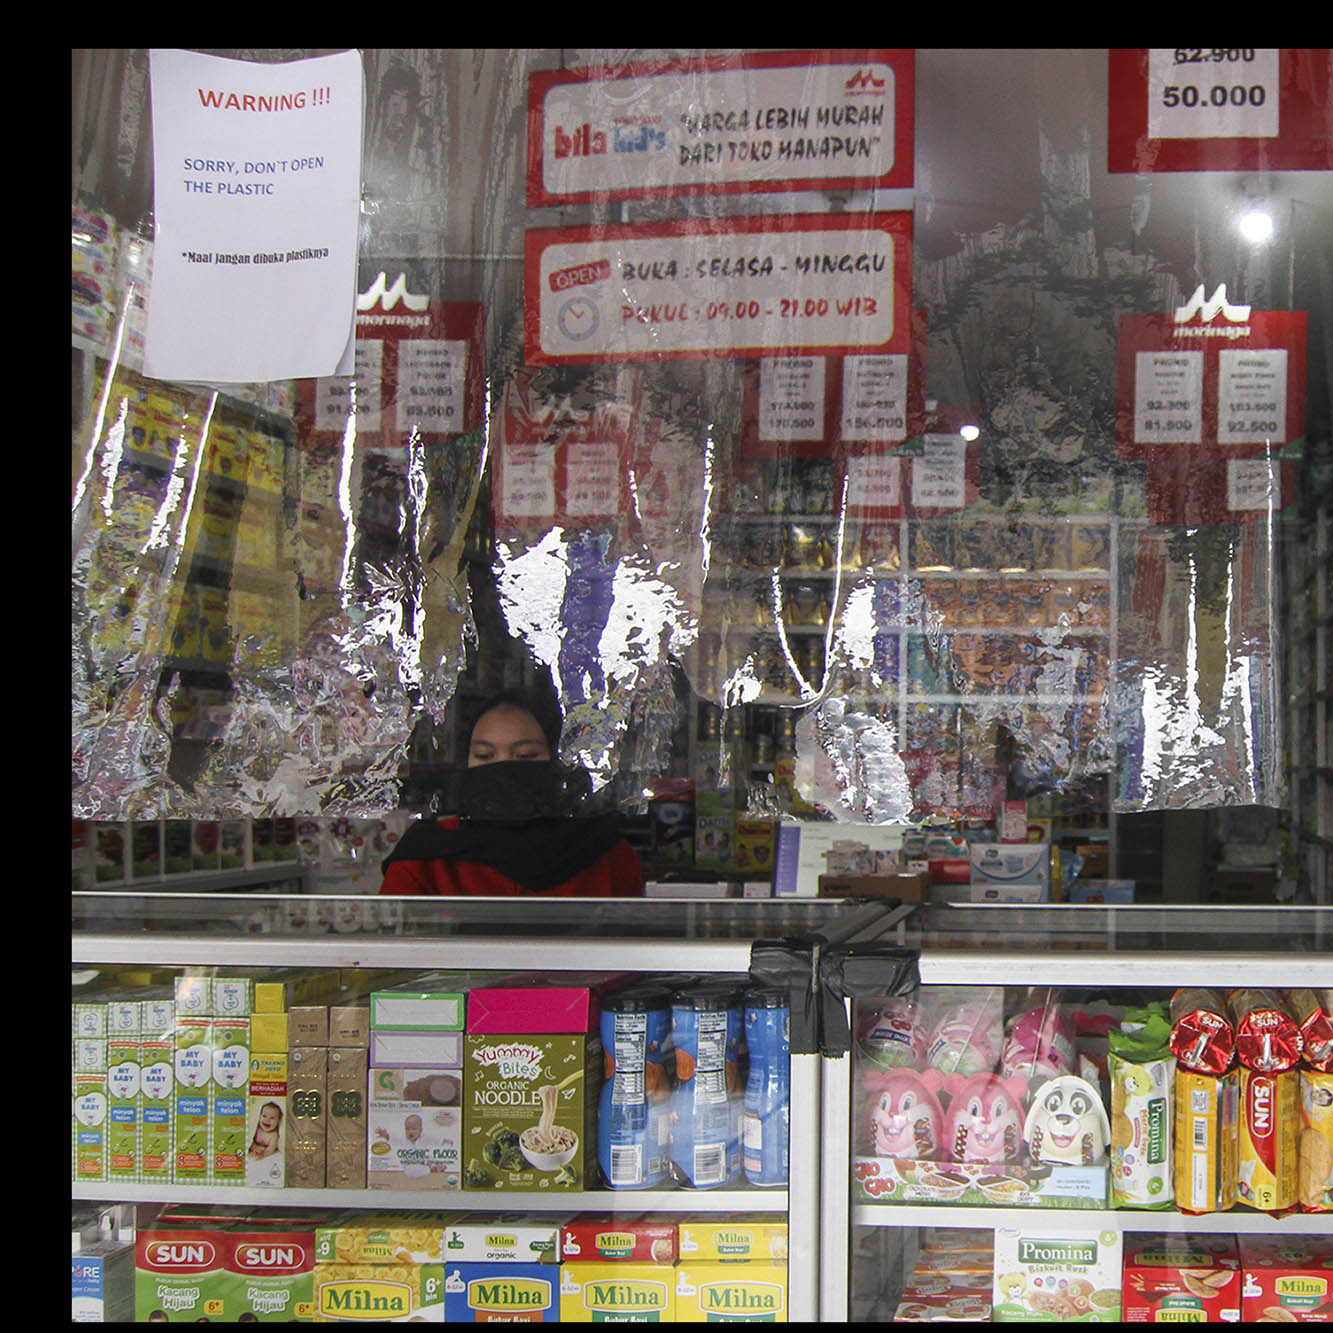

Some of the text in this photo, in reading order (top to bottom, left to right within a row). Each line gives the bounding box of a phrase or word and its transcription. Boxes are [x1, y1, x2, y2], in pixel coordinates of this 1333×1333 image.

[198, 88, 331, 112] WARNING !!!
[1164, 85, 1265, 107] 50.000
[755, 104, 884, 130] LEBIH MURAH
[680, 144, 722, 165] DARI
[729, 140, 773, 162] TOKO
[184, 158, 239, 176] SORRY,
[291, 155, 325, 171] OPEN
[184, 181, 274, 196] THE PLASTIC
[215, 252, 250, 265] jangan
[253, 253, 284, 264] dibuka
[286, 247, 329, 262] plastiknya
[557, 267, 600, 288] OPEN
[623, 254, 885, 281] BUKA SELASA MINGGU
[476, 1044, 538, 1064] Yummy
[502, 1062, 539, 1077] Bites
[486, 1081, 529, 1091] ORGANIC
[156, 1246, 205, 1262] SUN
[1021, 1242, 1093, 1262] Promina
[158, 1287, 198, 1299] Kacang
[326, 1290, 403, 1312] Milna
[477, 1284, 542, 1305] Milna
[163, 1298, 195, 1311] Hijau
